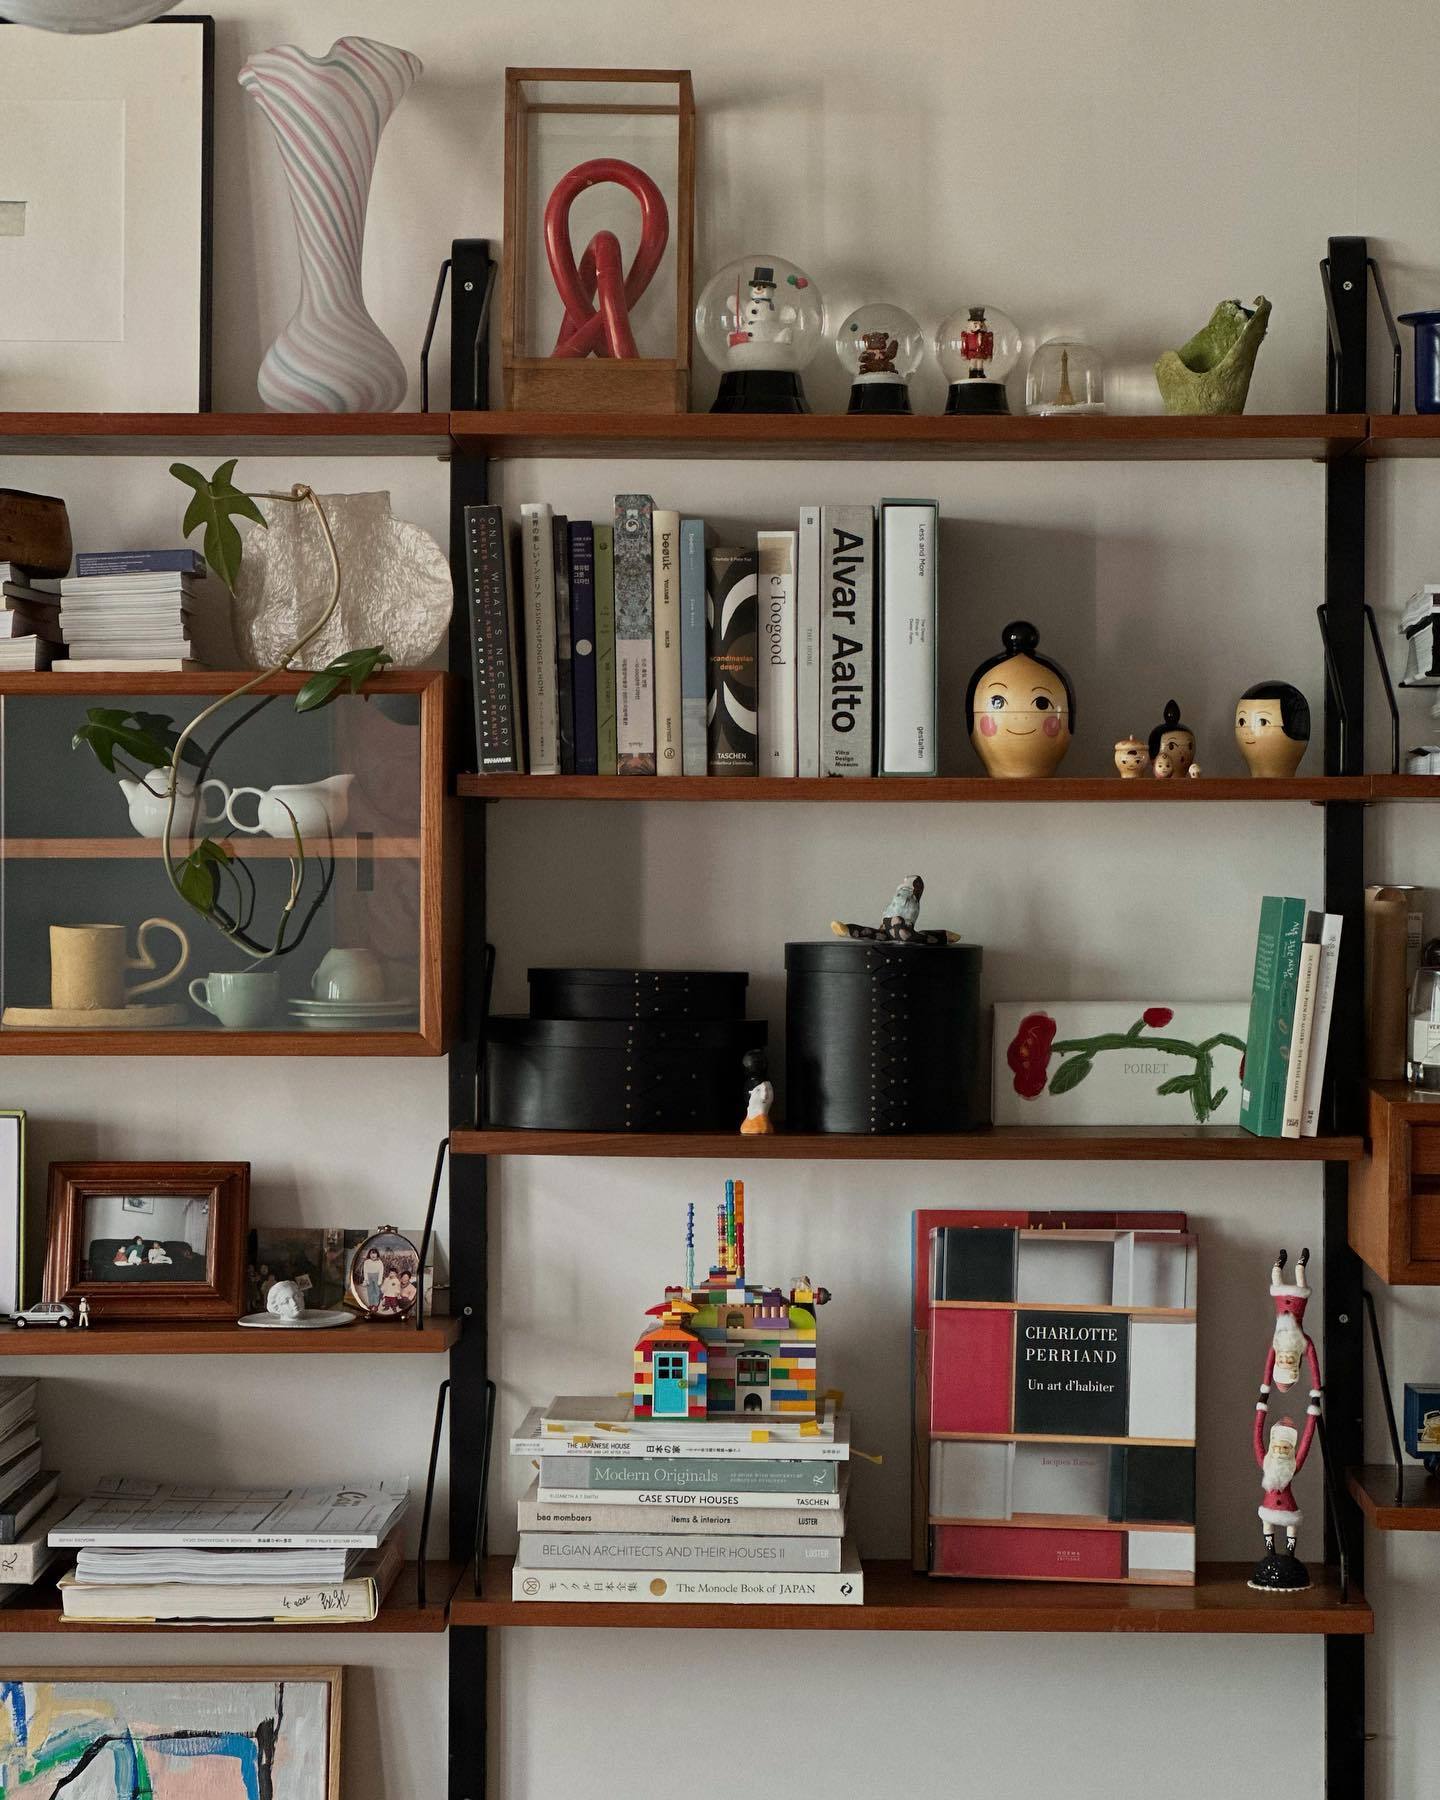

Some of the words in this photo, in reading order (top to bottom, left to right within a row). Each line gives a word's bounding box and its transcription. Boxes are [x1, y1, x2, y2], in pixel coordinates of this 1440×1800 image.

[471, 518, 479, 555] CHIP
[918, 523, 926, 541] Less
[918, 543, 926, 557] and
[918, 558, 927, 577] More
[832, 527, 864, 625] Alvar
[488, 517, 498, 560] ONLY
[496, 648, 509, 747] NECESSARY
[766, 591, 786, 666] Toogood
[477, 637, 486, 685] GEOFF
[719, 663, 744, 672] design
[831, 633, 864, 733] Aalto
[481, 700, 490, 748] SPEAR
[916, 726, 924, 759] gestalten
[717, 752, 747, 760] TASCHEN
[1124, 1063, 1169, 1074] POIRET
[1025, 1326, 1118, 1341] CHARLOTTE
[1026, 1348, 1117, 1363] PERRIAND
[1028, 1379, 1044, 1390] Un
[1047, 1381, 1062, 1391] art
[1065, 1379, 1115, 1392] d'habiter
[580, 1442, 609, 1450] JAPANESE
[610, 1442, 631, 1450] HOUSE
[594, 1467, 650, 1481] Modern
[654, 1468, 719, 1486] Originals
[638, 1494, 662, 1504] CASE
[665, 1495, 696, 1504] STUDY
[699, 1496, 739, 1505] HOUSES
[536, 1513, 551, 1522] bea
[553, 1513, 592, 1522] mombaers
[671, 1516, 690, 1524] items
[700, 1516, 731, 1524] interiors
[542, 1544, 591, 1556] BELGIAN
[594, 1545, 663, 1557] ARCHITECTS
[665, 1546, 693, 1558] AND
[695, 1547, 727, 1558] THEIR
[729, 1547, 776, 1558] HOUSES
[676, 1583, 694, 1593] The
[698, 1584, 738, 1593] Monocle
[741, 1584, 764, 1594] Book
[767, 1584, 777, 1594] of
[779, 1585, 816, 1595] JAPAN
